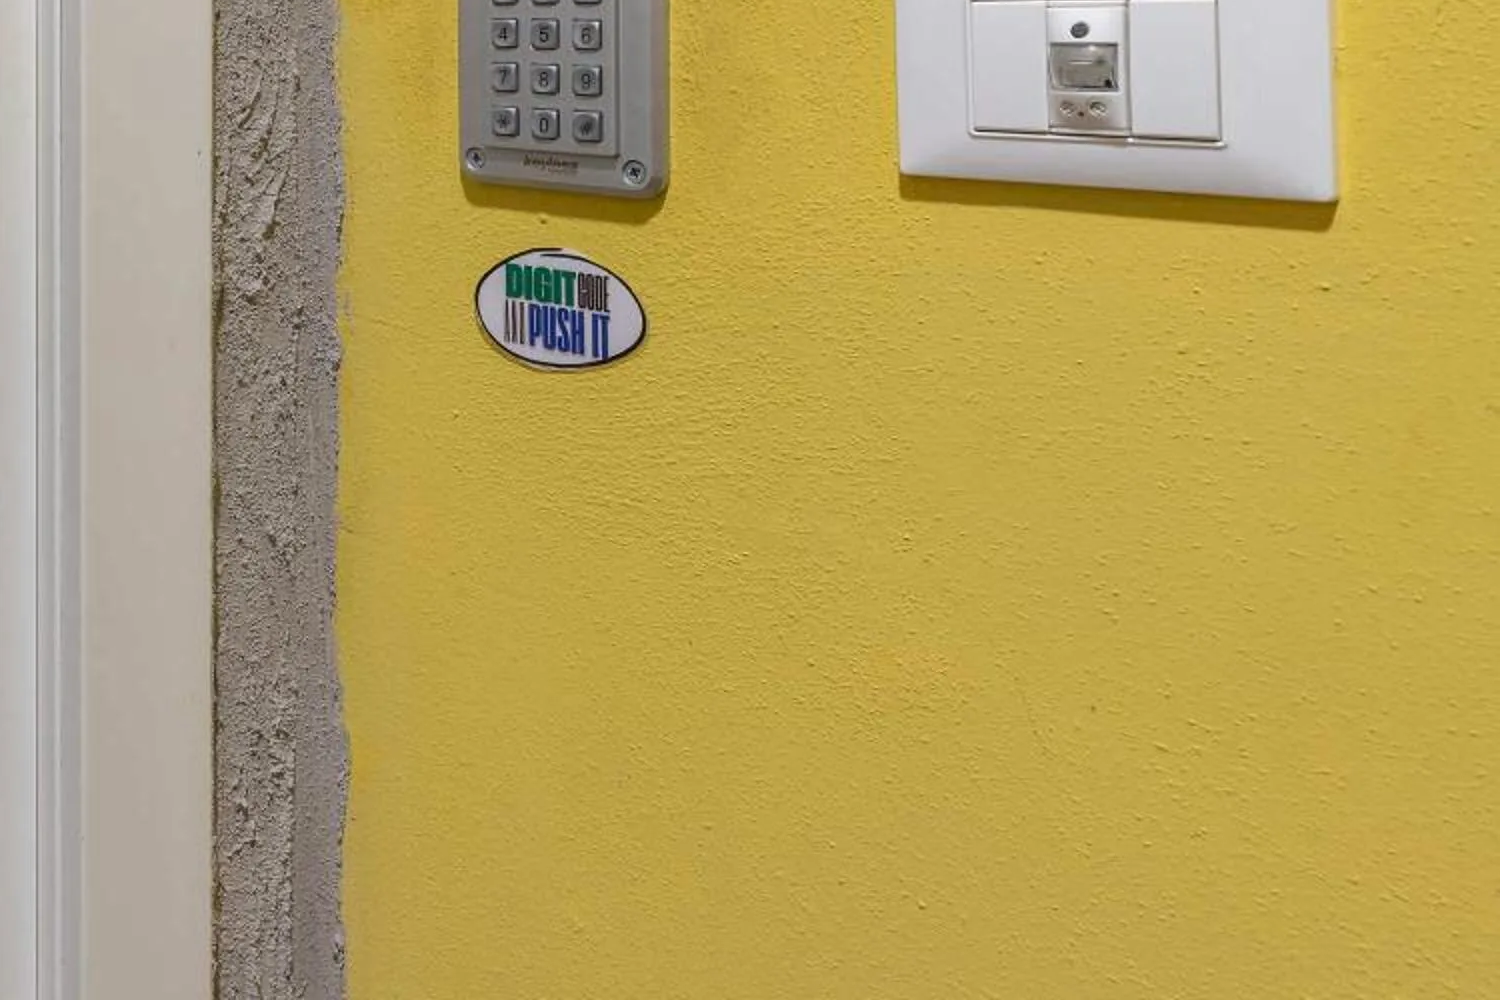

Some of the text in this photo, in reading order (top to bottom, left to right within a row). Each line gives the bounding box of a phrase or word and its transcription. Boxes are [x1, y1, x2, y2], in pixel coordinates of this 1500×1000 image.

[538, 25, 550, 43] 5
[580, 26, 592, 44] 6
[537, 70, 550, 87] 8
[580, 72, 592, 90] 9
[505, 263, 576, 309] DIGIT
[528, 303, 586, 356] PUSH
[591, 312, 611, 360] IT
